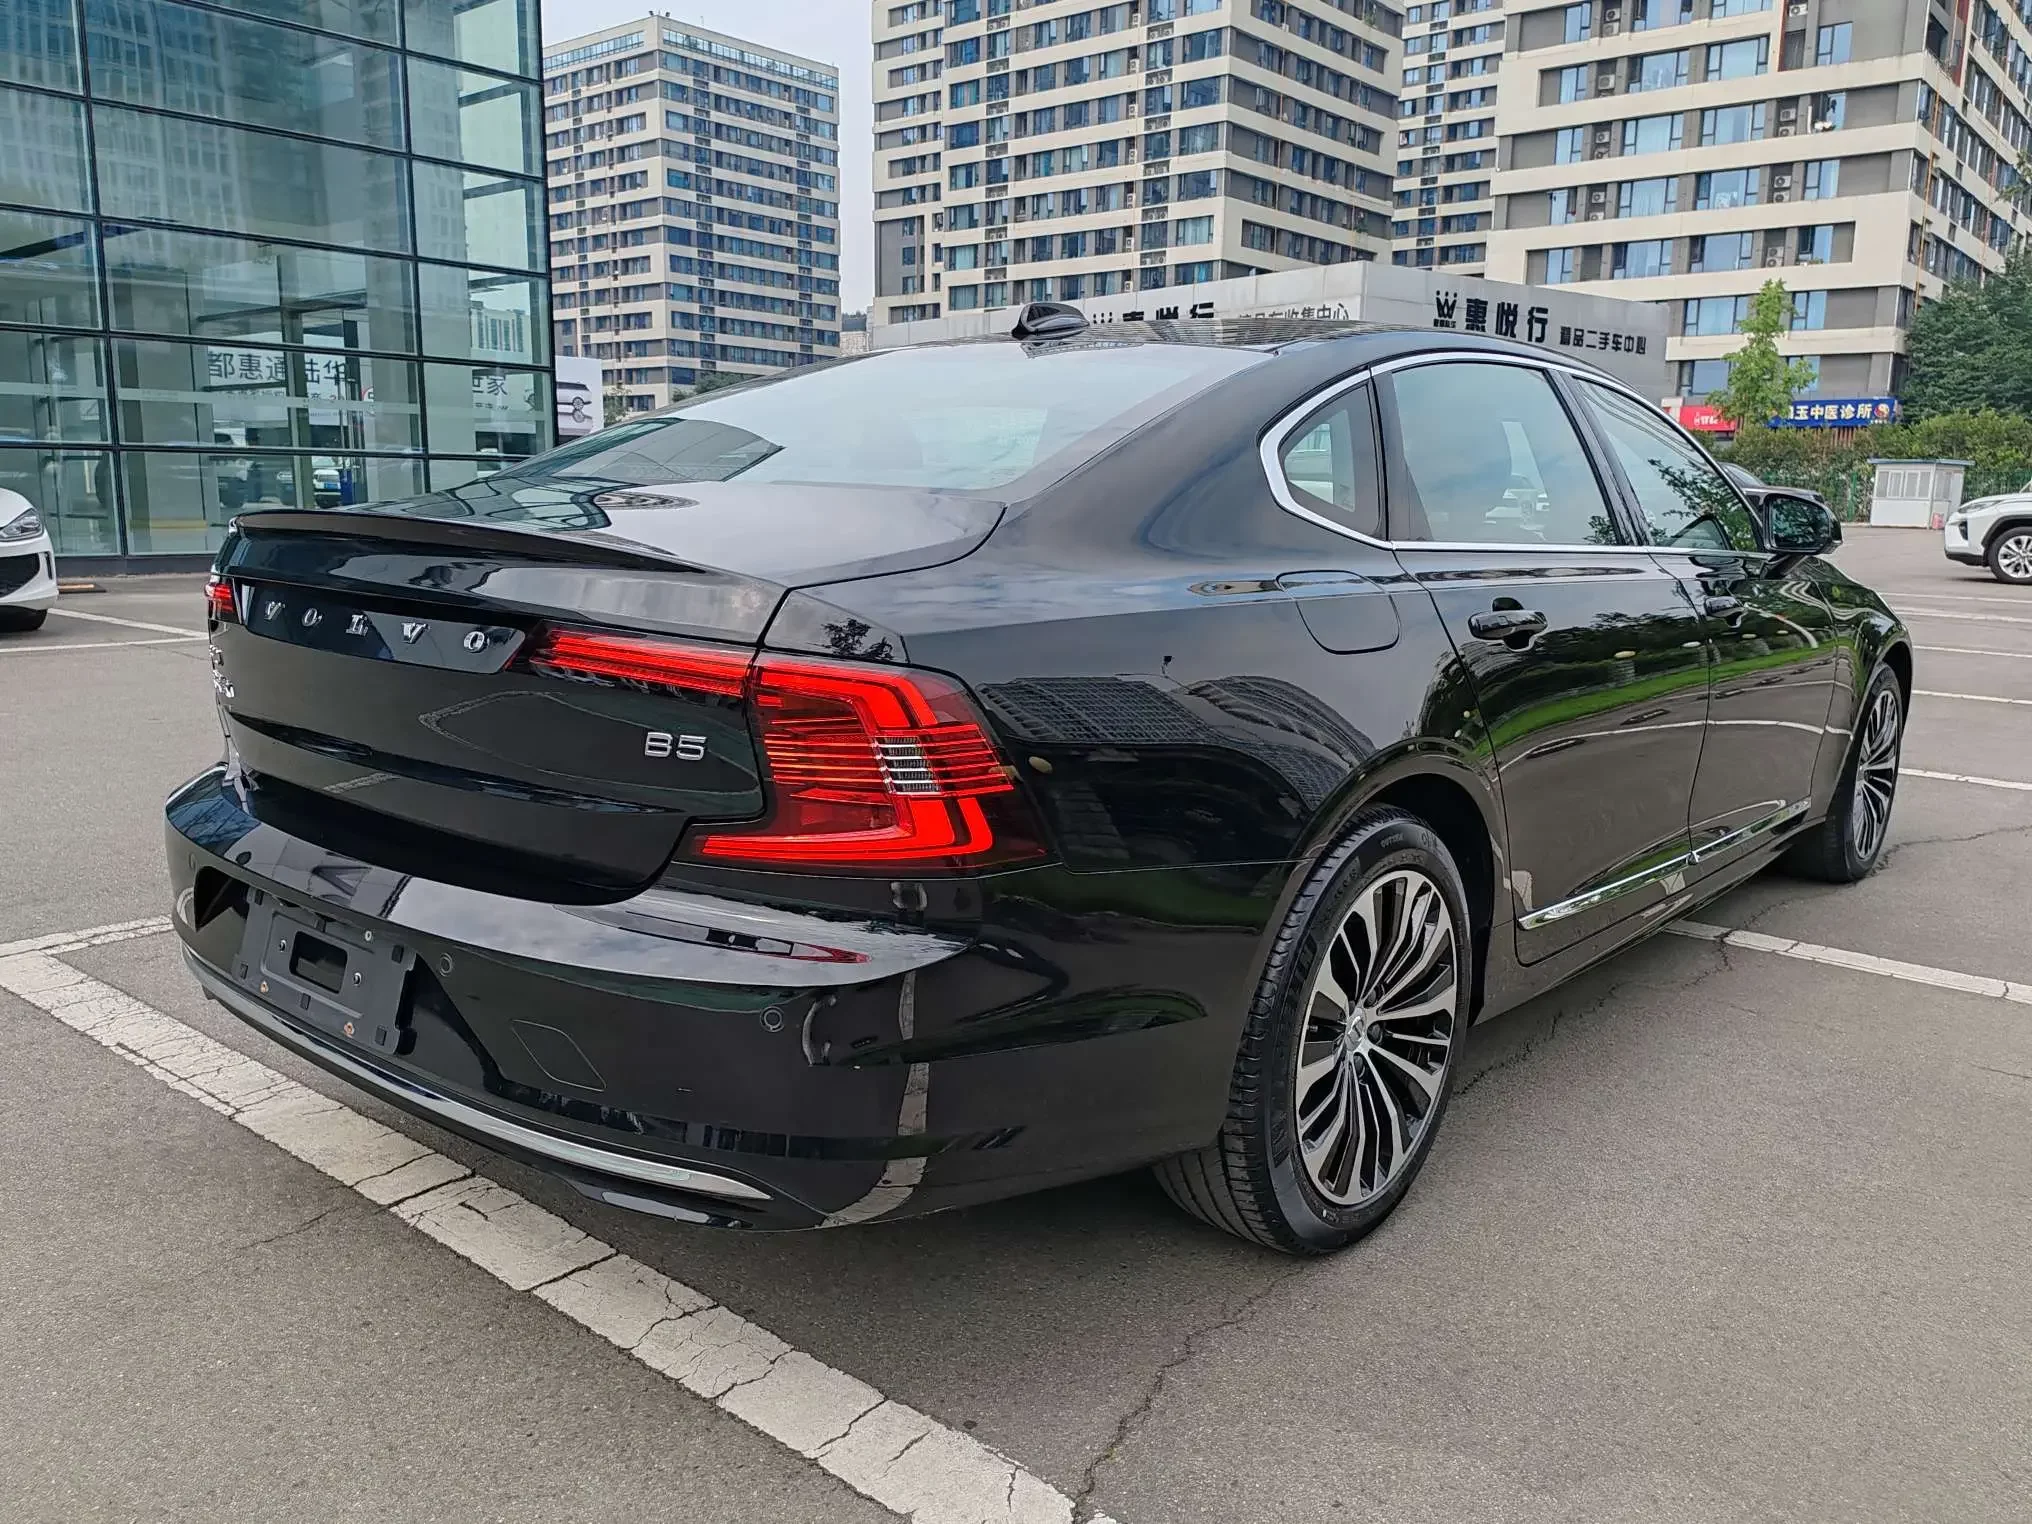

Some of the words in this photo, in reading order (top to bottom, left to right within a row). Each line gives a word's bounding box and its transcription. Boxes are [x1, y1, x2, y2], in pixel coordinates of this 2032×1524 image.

[1464, 298, 1549, 343] 惠悦行
[1559, 326, 1647, 354] 精品二手车中心
[263, 601, 489, 653] VOLVO
[645, 732, 707, 760] B5
